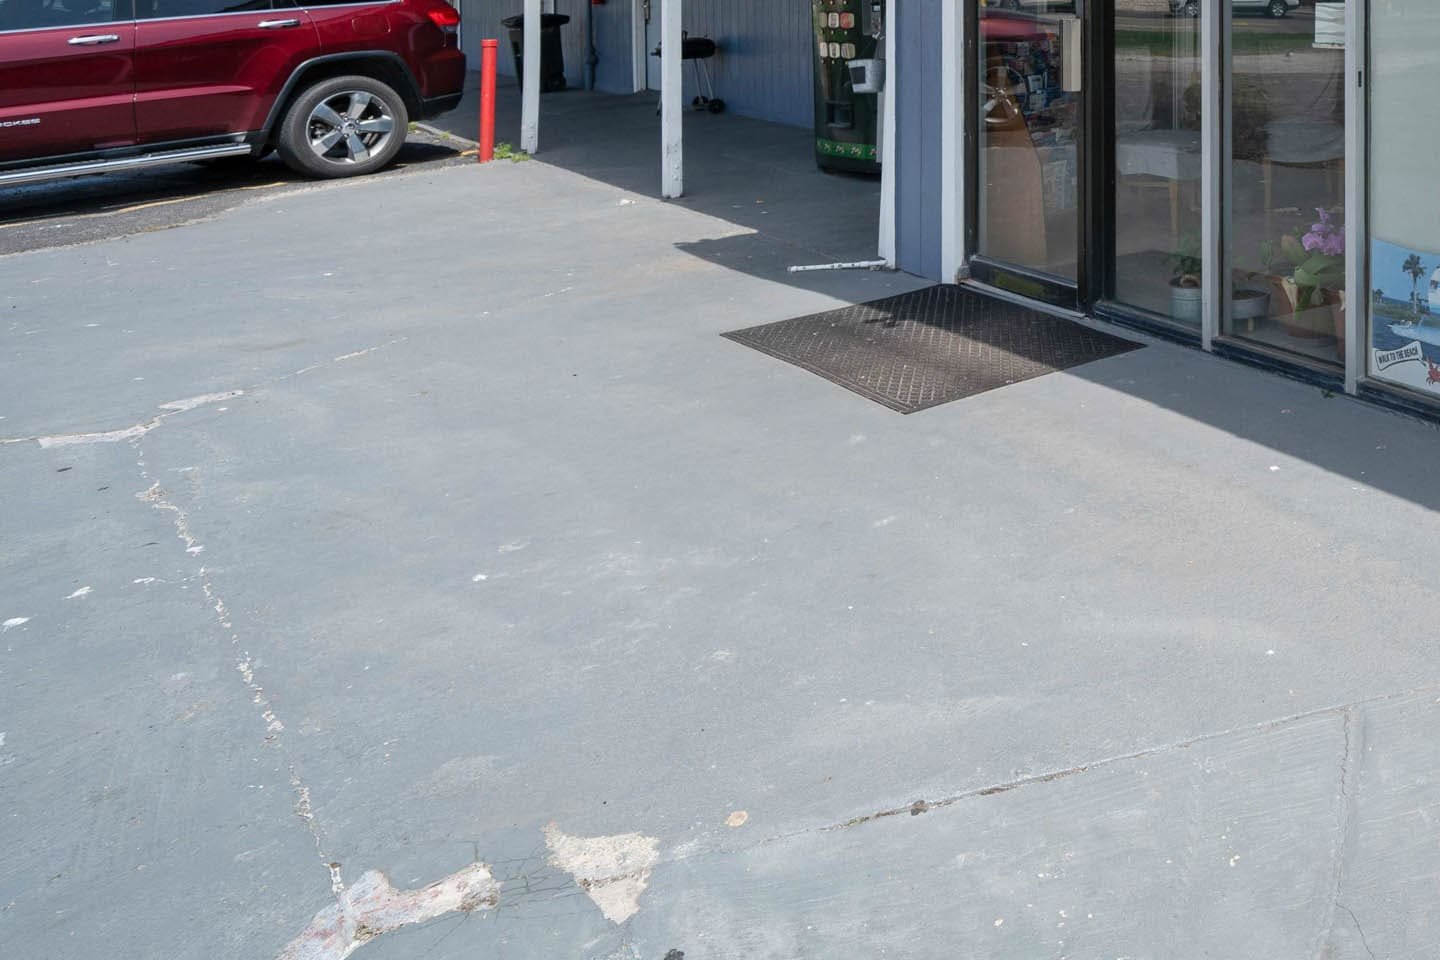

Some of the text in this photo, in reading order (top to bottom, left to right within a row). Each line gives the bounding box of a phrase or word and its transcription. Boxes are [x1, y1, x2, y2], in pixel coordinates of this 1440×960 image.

[0, 118, 41, 127] OKEE
[1378, 353, 1390, 364] WALK
[1404, 345, 1419, 358] BEACH
